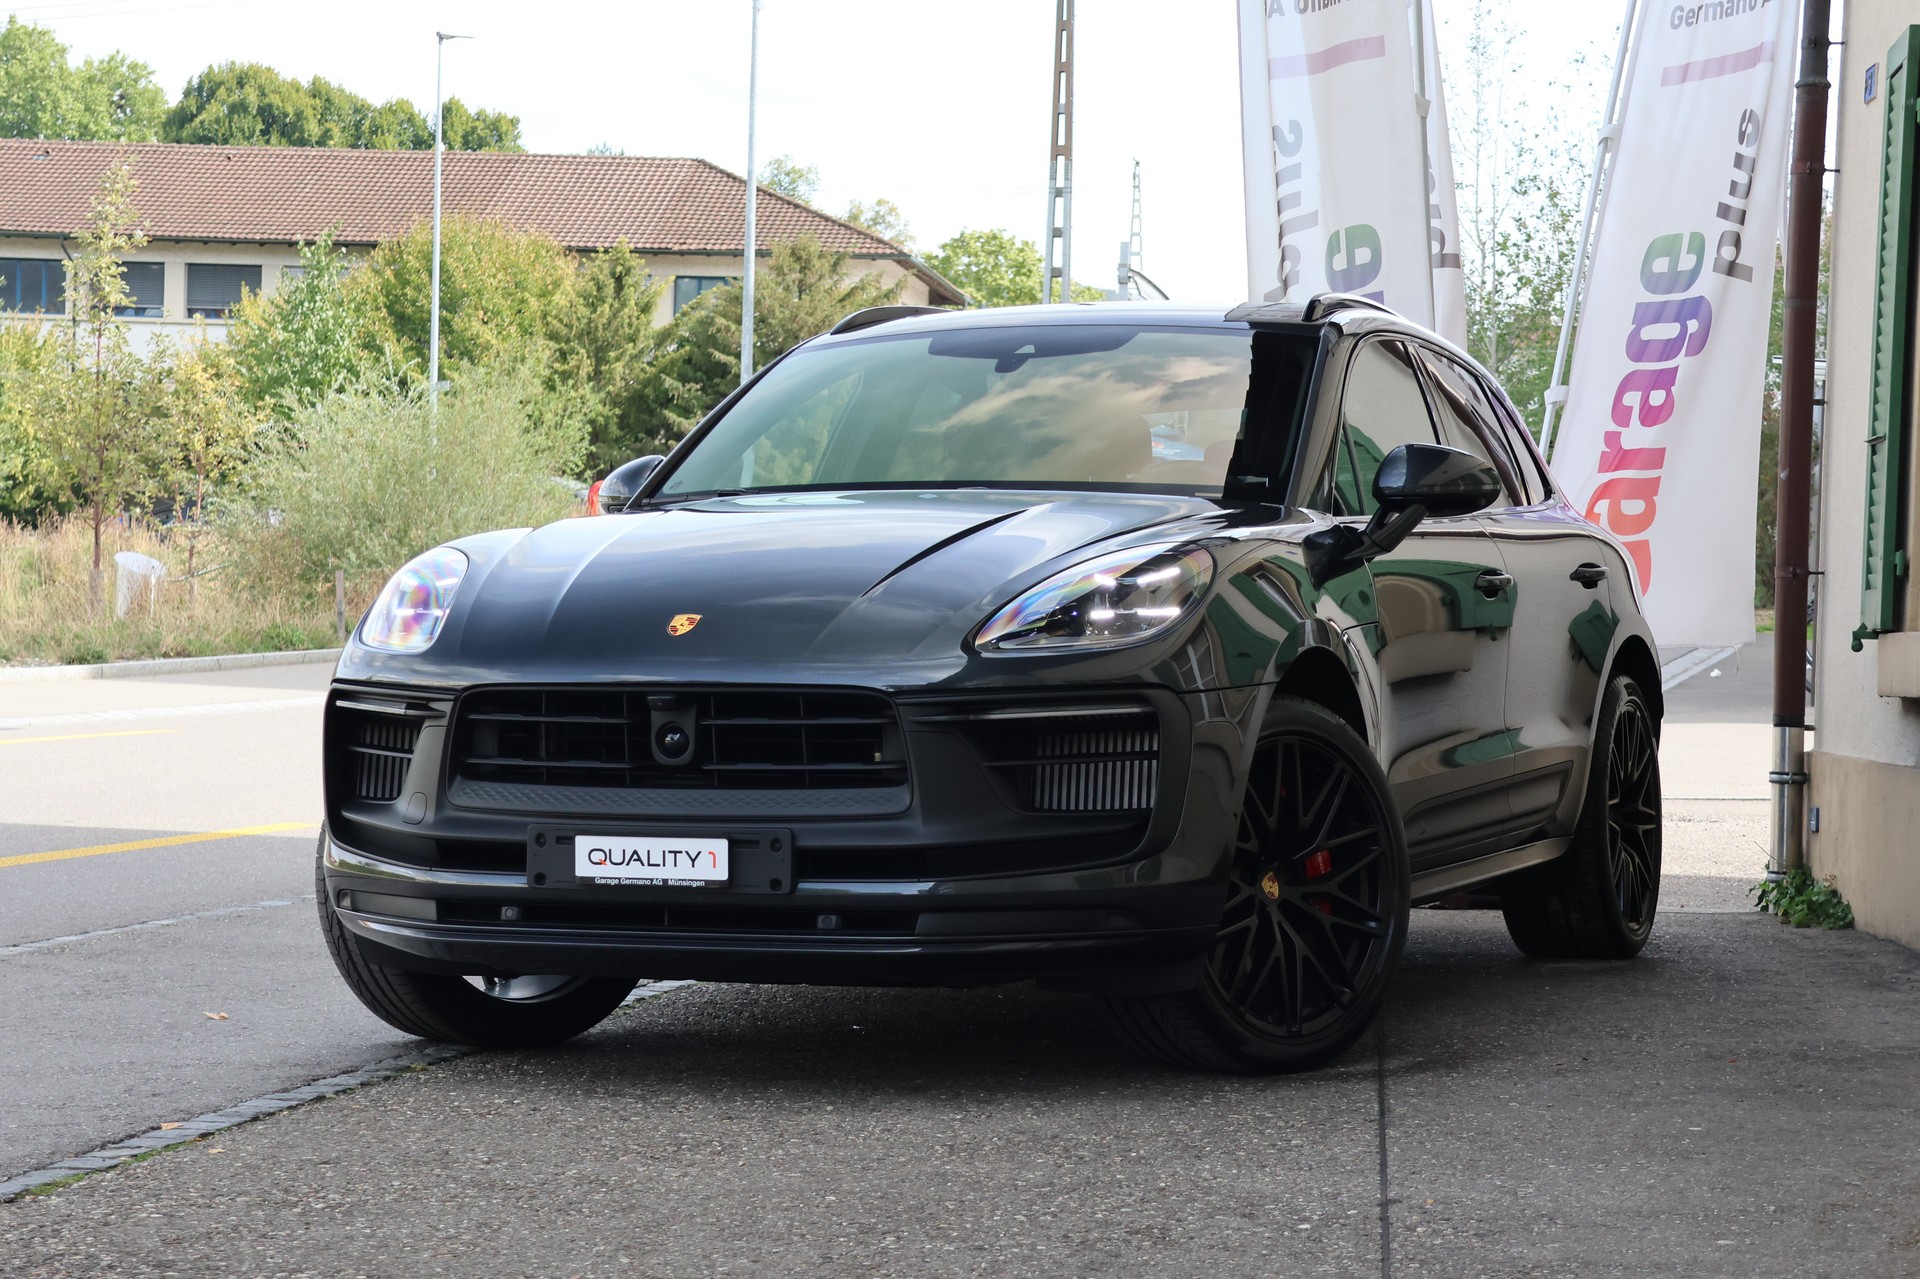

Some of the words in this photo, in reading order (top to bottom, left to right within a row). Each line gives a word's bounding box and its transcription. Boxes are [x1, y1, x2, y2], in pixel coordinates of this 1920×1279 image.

[1713, 108, 1761, 283] plus
[588, 848, 702, 868] QUALITY
[708, 851, 717, 868] 1
[595, 877, 619, 886] Garage
[620, 877, 651, 886] Germano
[652, 878, 663, 886] AG
[668, 879, 705, 887] Münsingen
